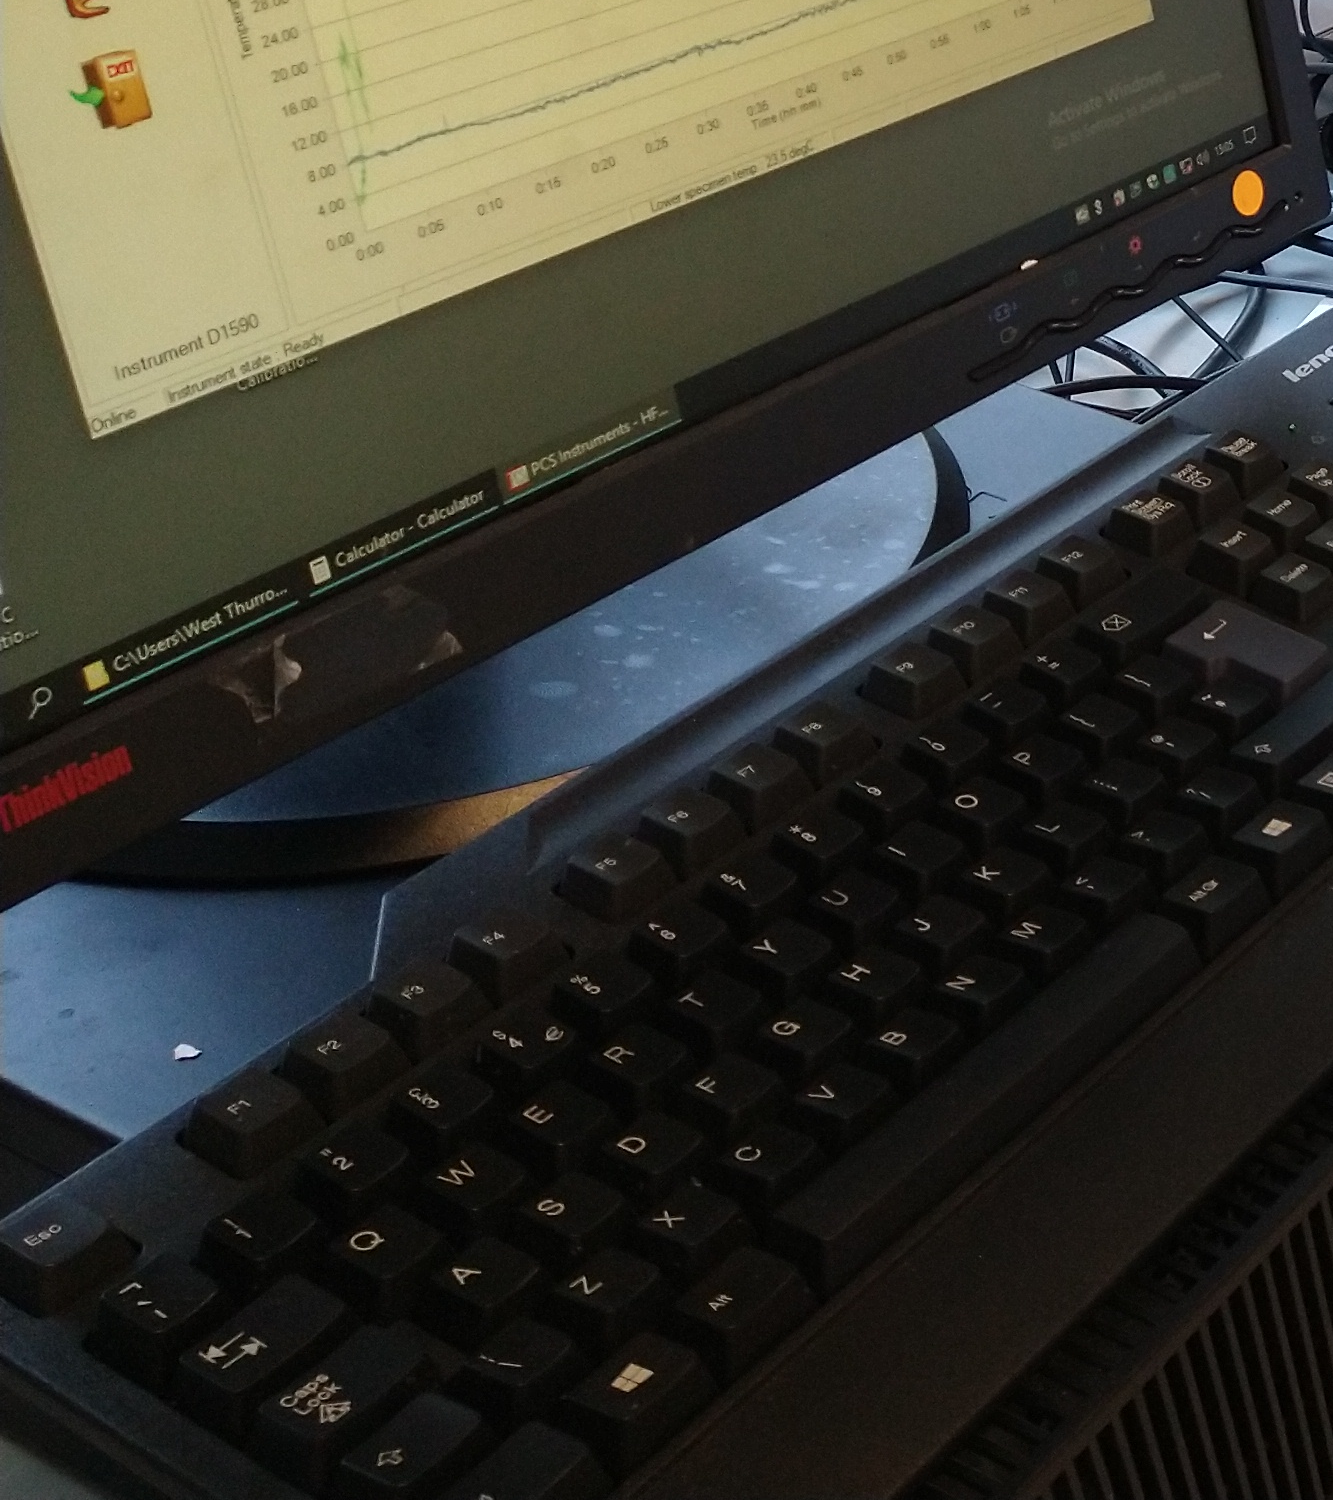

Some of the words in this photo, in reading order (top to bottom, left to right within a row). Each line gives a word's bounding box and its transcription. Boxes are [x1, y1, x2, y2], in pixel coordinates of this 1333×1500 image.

[260, 26, 300, 49] 24.00
[650, 191, 681, 213] Lower
[114, 336, 205, 381] Instrument
[207, 313, 261, 347] D1590
[91, 405, 138, 433] Online
[167, 366, 236, 403] Instrument
[238, 351, 272, 377] state
[282, 331, 326, 357] Ready
[529, 453, 559, 477] PCS
[560, 421, 632, 462] Instruments
[335, 528, 406, 568] Calculator
[416, 488, 486, 530] Calculator
[0, 744, 133, 834] ThinkVision
[972, 865, 1001, 882] K
[1010, 920, 1043, 940] M
[753, 937, 779, 956] Y
[840, 963, 872, 983] H
[770, 1019, 802, 1037] G
[878, 1029, 908, 1047] B
[602, 1044, 636, 1066] R
[522, 1103, 554, 1125] E
[616, 1135, 648, 1155] D
[734, 1145, 762, 1163] C
[436, 1159, 477, 1187] W
[537, 1198, 566, 1218] S
[653, 1209, 686, 1230] X
[24, 1223, 64, 1248] Esc
[350, 1230, 386, 1252] Q
[451, 1265, 482, 1286] A
